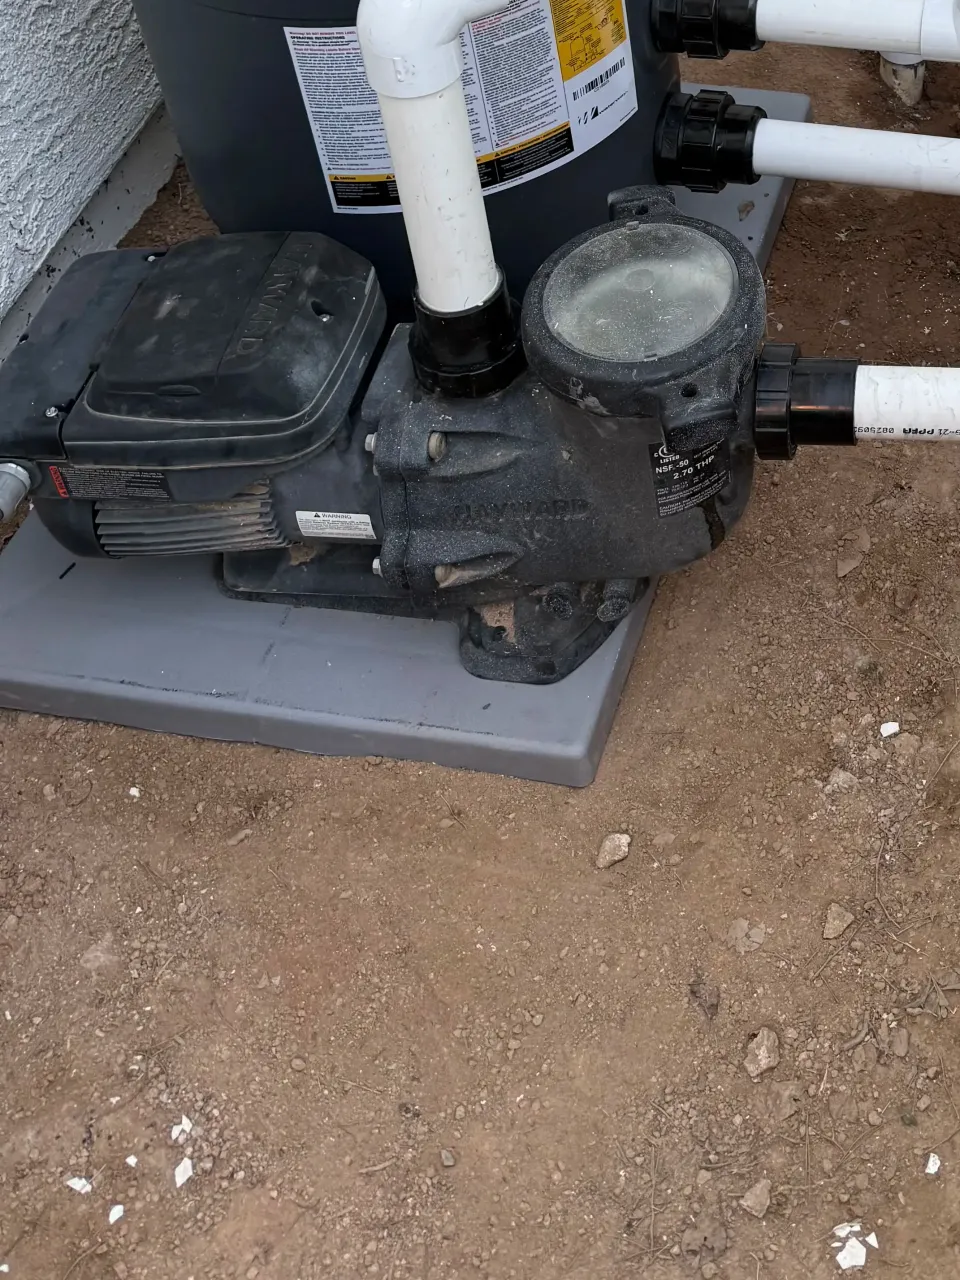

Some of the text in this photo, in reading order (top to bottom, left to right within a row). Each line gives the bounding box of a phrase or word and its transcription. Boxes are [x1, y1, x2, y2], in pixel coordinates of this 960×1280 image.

[902, 427, 935, 435] PPFA
[659, 454, 680, 464] LISTED
[673, 455, 715, 480] 2.70 THP
